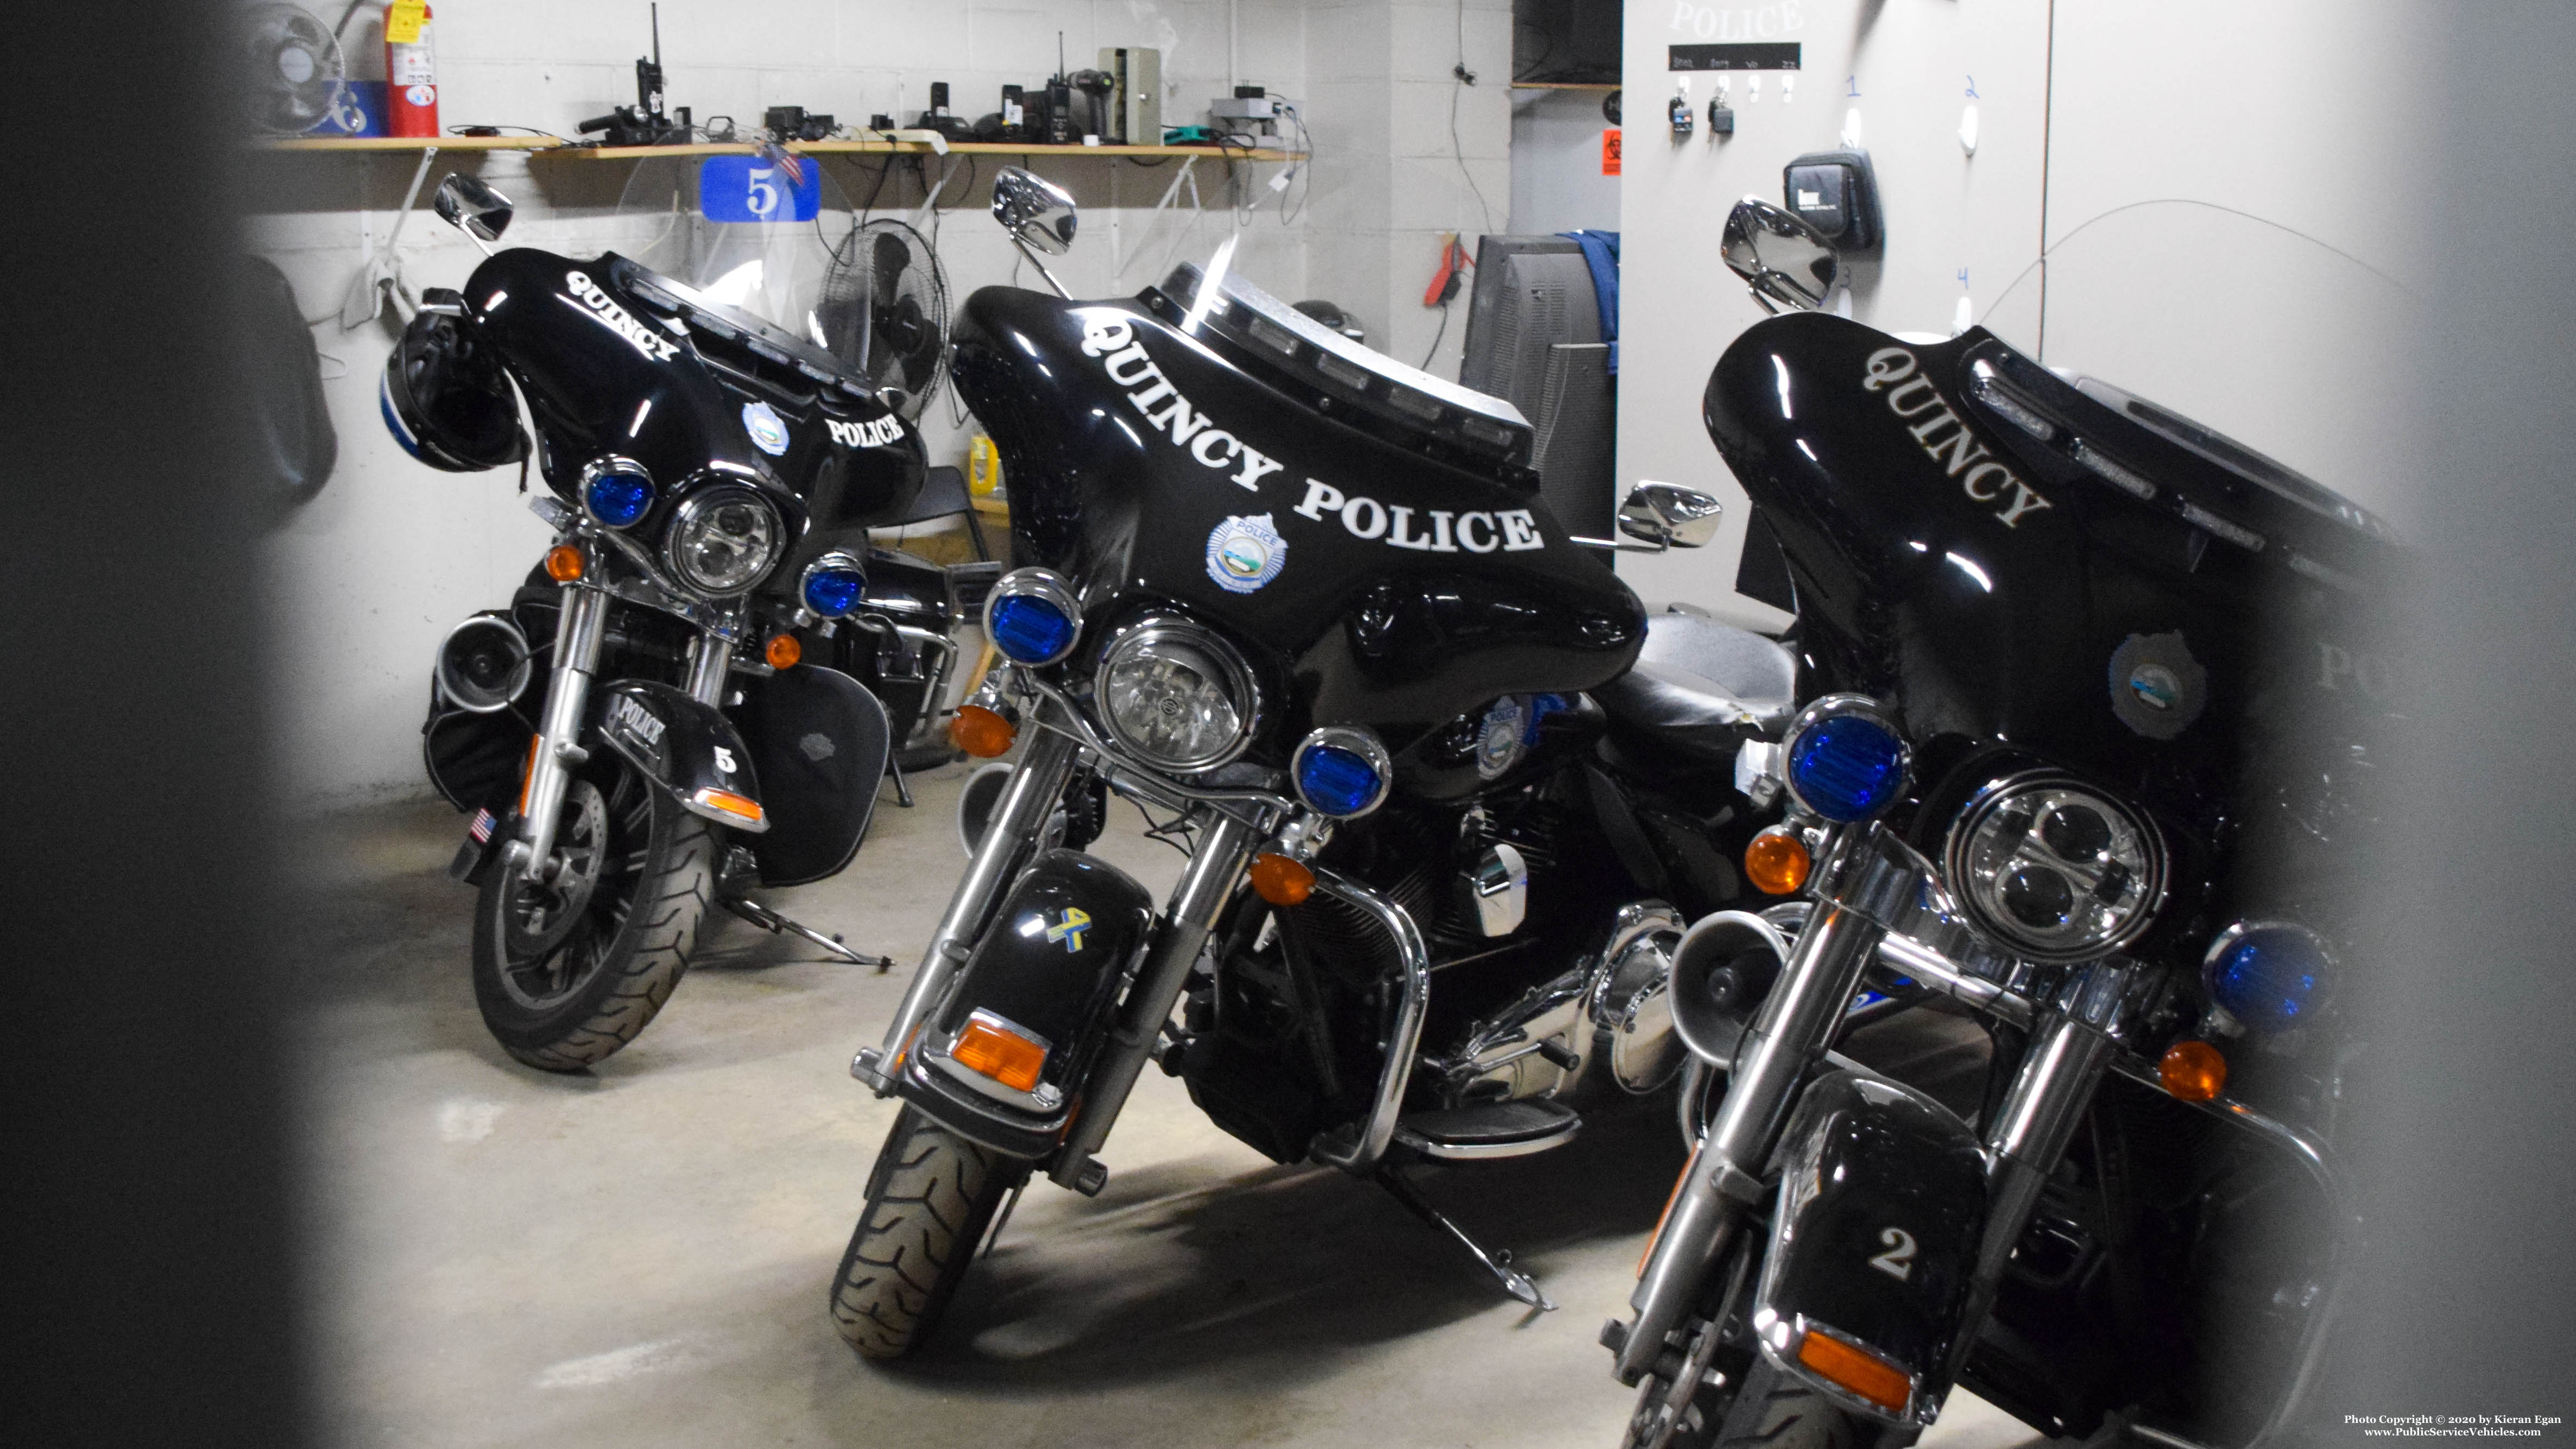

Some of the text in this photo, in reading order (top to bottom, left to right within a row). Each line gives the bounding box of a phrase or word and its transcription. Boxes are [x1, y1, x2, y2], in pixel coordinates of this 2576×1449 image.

[1669, 1, 1803, 40] POLICE
[1846, 74, 1862, 97] 1
[1965, 74, 1980, 99] 2
[747, 168, 778, 215] 5
[1958, 267, 1969, 291] 4
[566, 270, 905, 448] QUINCY POLICE
[1081, 313, 1545, 553] QUINCY POLICE
[1863, 347, 2053, 528] QUINCY
[1237, 520, 1278, 546] POLICE
[618, 696, 666, 745] POLICE
[714, 745, 737, 773] 5
[1870, 1227, 1917, 1280] 2
